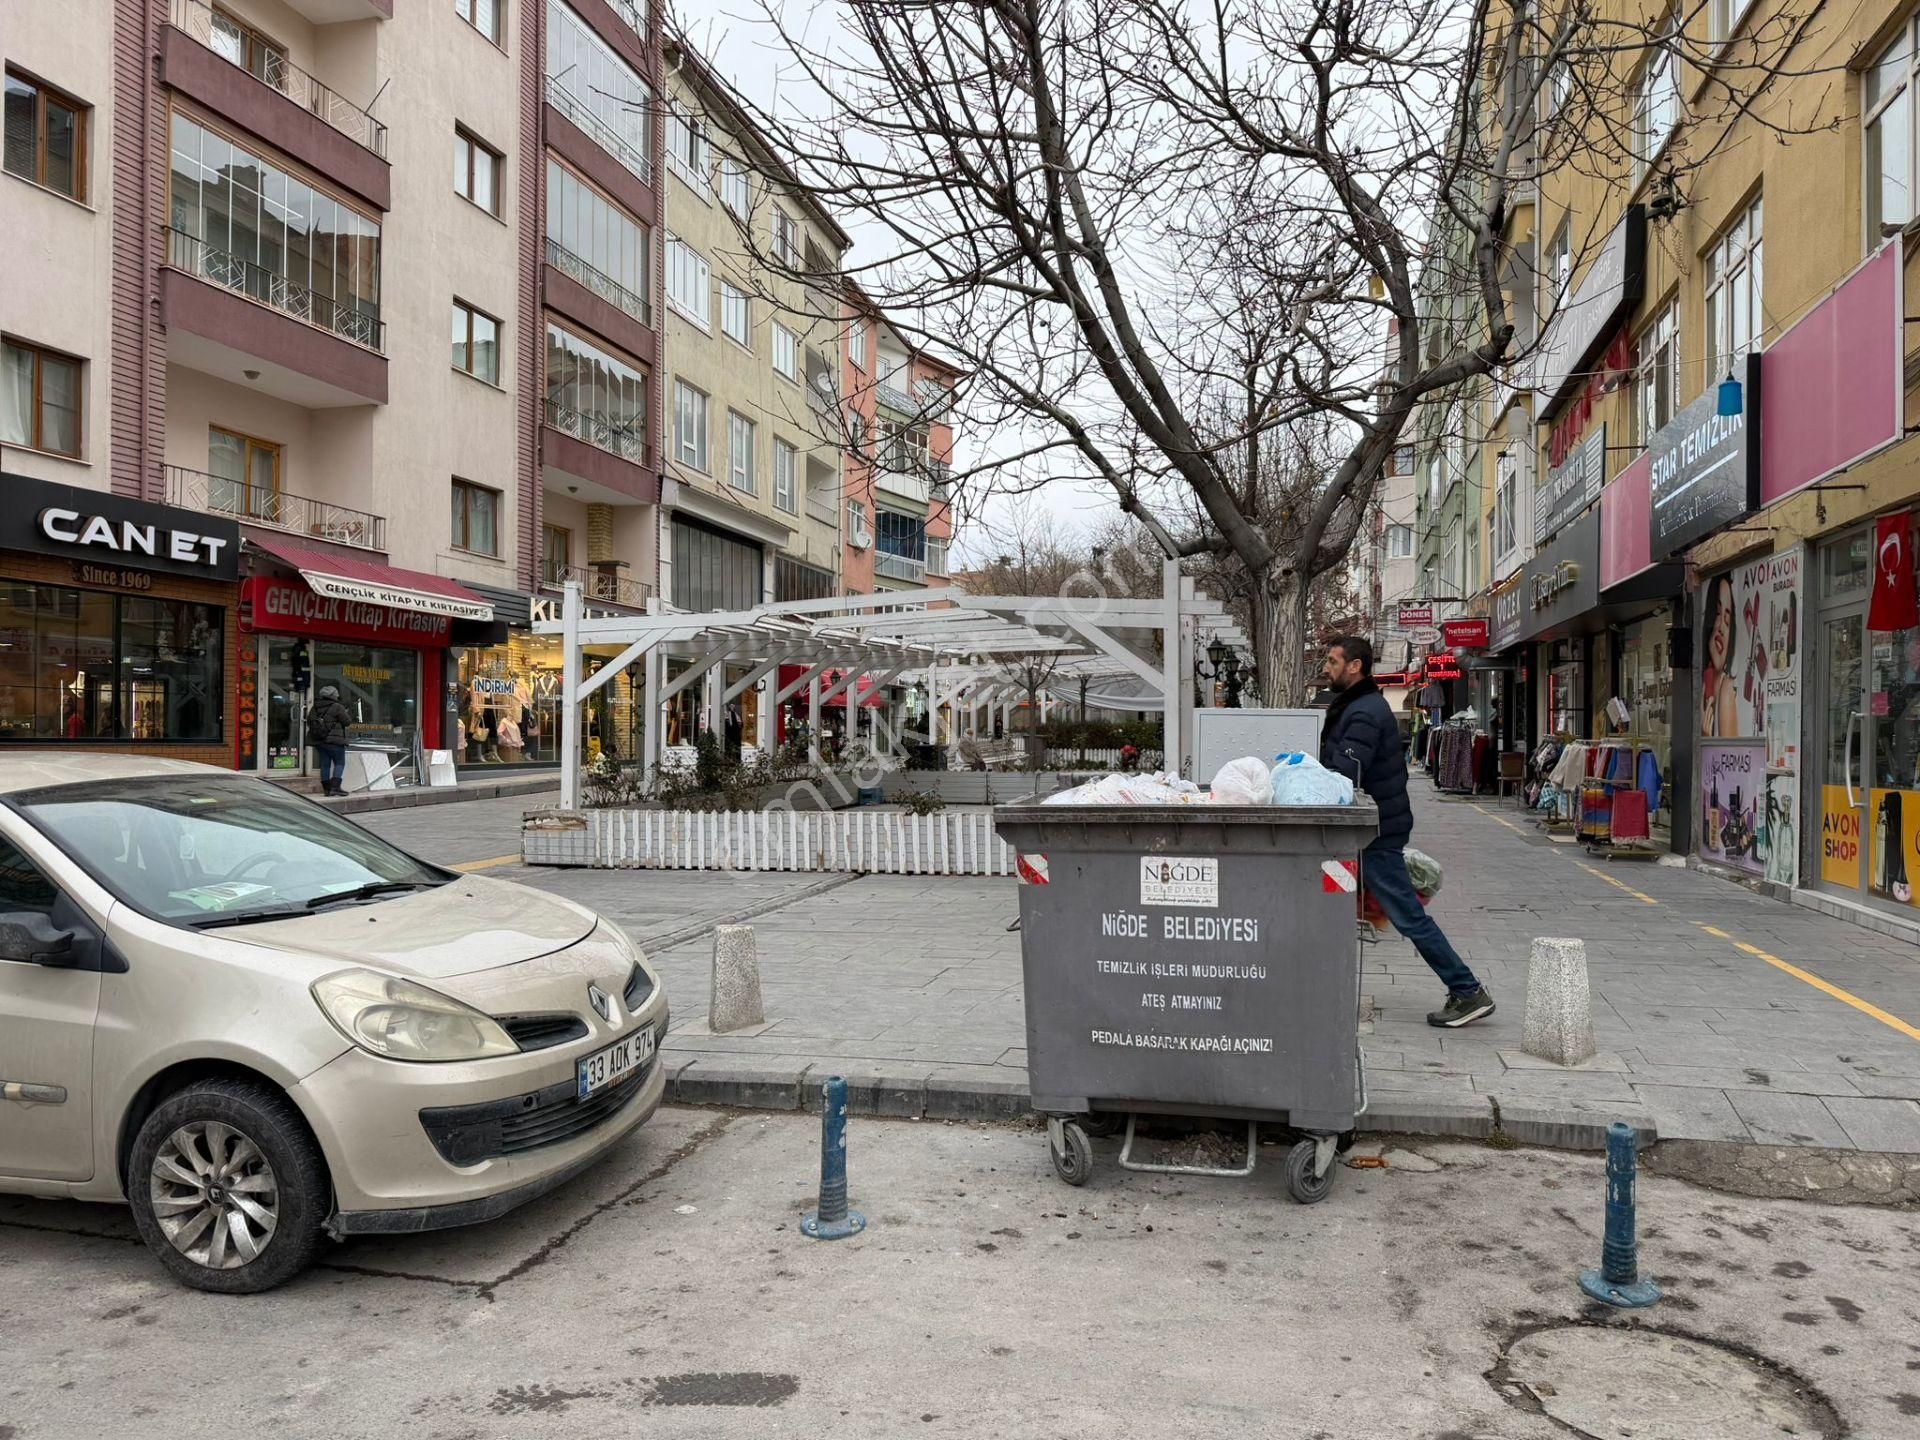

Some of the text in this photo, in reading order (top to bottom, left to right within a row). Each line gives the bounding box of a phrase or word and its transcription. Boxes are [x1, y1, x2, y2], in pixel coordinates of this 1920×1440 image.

[1652, 447, 1677, 491] STAR
[43, 508, 227, 566] CAN ET
[82, 565, 150, 589] Since 1969
[1743, 563, 1770, 591] AVO
[1772, 555, 1798, 579] AVON
[325, 583, 480, 616] GENÇLİK KİTAP VE KIRTASİYE
[344, 602, 383, 632] Kitap
[1767, 676, 1796, 698] FARMASİ
[1720, 751, 1752, 773] FARMASİ
[1823, 812, 1860, 838] AVON
[1825, 838, 1857, 861] SHOP
[1102, 910, 1258, 942] NİĞDE BELEDİYESİ
[1097, 960, 1266, 979] TEMİZLİK İŞLERİ MÜDÜRLÜĞÜ
[1141, 993, 1222, 1011] ATEŞ ATMAYINIZ
[1092, 1030, 1133, 1047] PEDALA
[1190, 1035, 1232, 1052] KAPAĞI
[1234, 1038, 1273, 1054] AÇINIZ!
[589, 1056, 604, 1086] 33
[635, 1029, 652, 1060] 974
